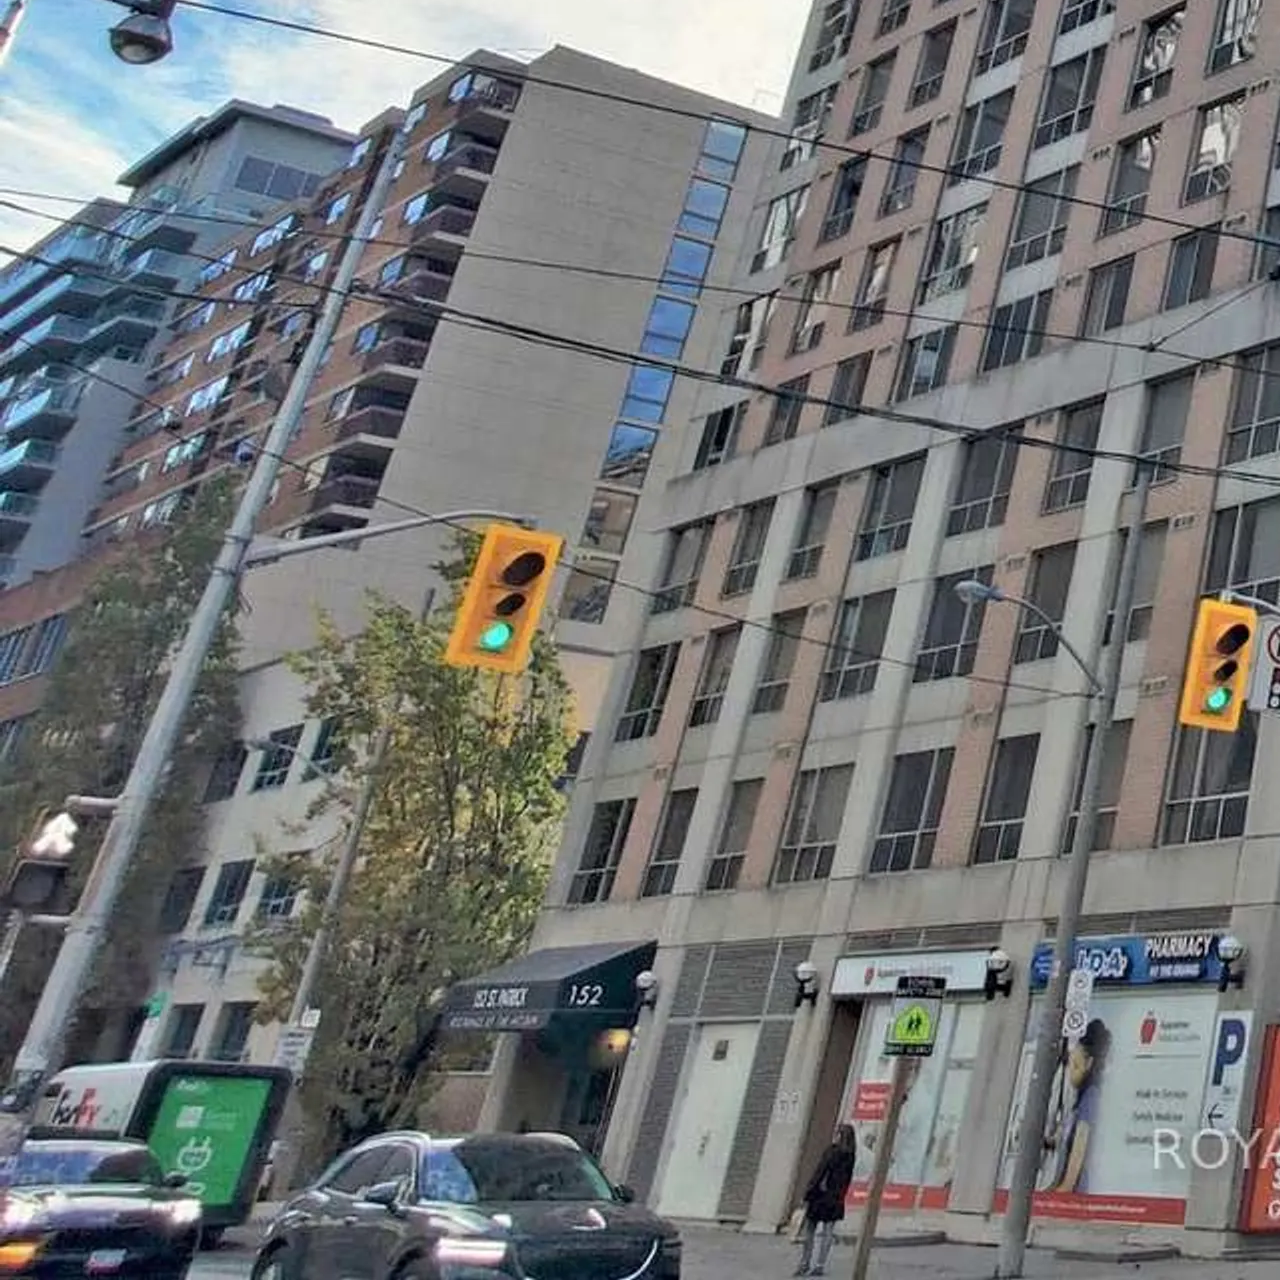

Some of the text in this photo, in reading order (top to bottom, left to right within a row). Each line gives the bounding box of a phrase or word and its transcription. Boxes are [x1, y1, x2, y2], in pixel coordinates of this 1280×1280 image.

[1143, 934, 1213, 959] PHARMACY
[568, 984, 604, 1006] 152
[1211, 1018, 1246, 1086] P
